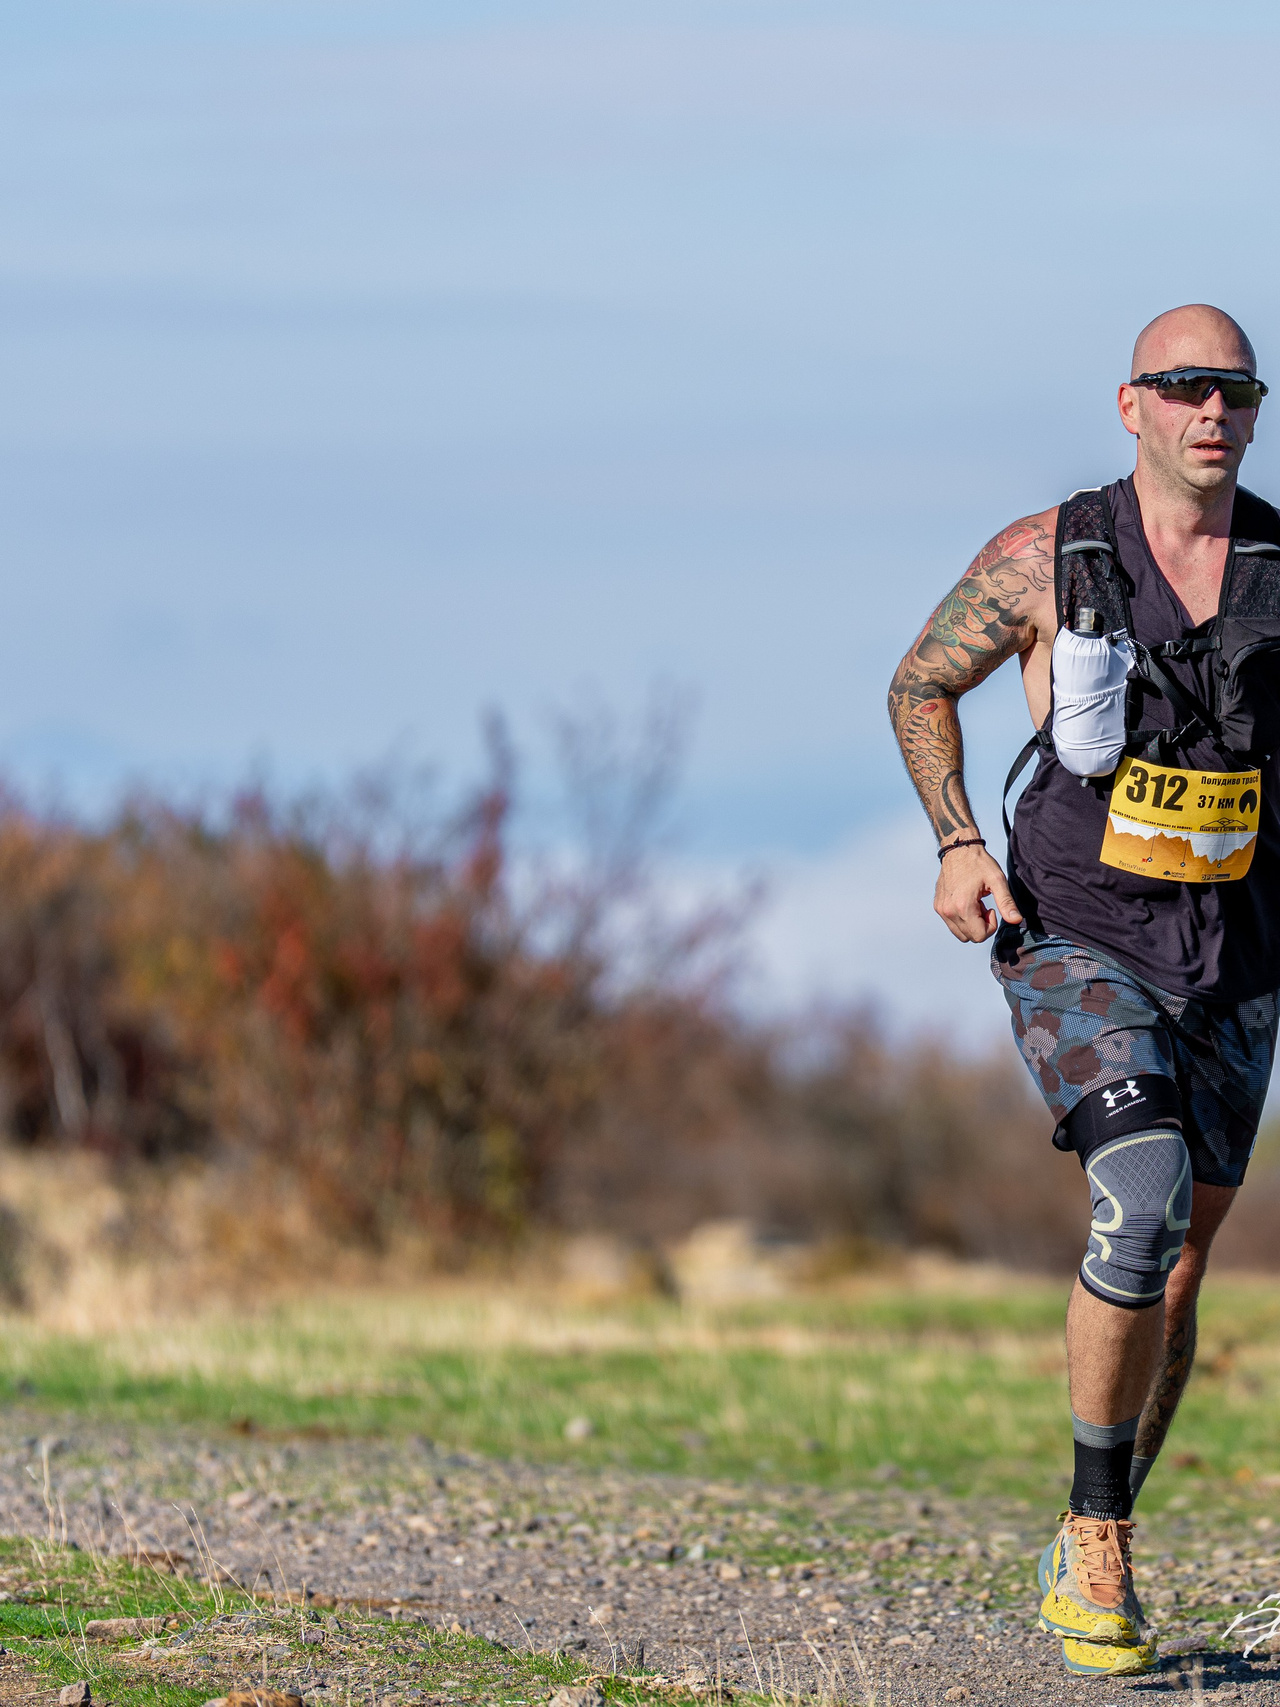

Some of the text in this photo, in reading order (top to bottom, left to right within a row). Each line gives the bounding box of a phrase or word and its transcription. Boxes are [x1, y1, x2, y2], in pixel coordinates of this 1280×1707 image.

[1201, 776, 1240, 786] Полудиво
[1126, 766, 1188, 811] 312
[1197, 795, 1215, 809] 37
